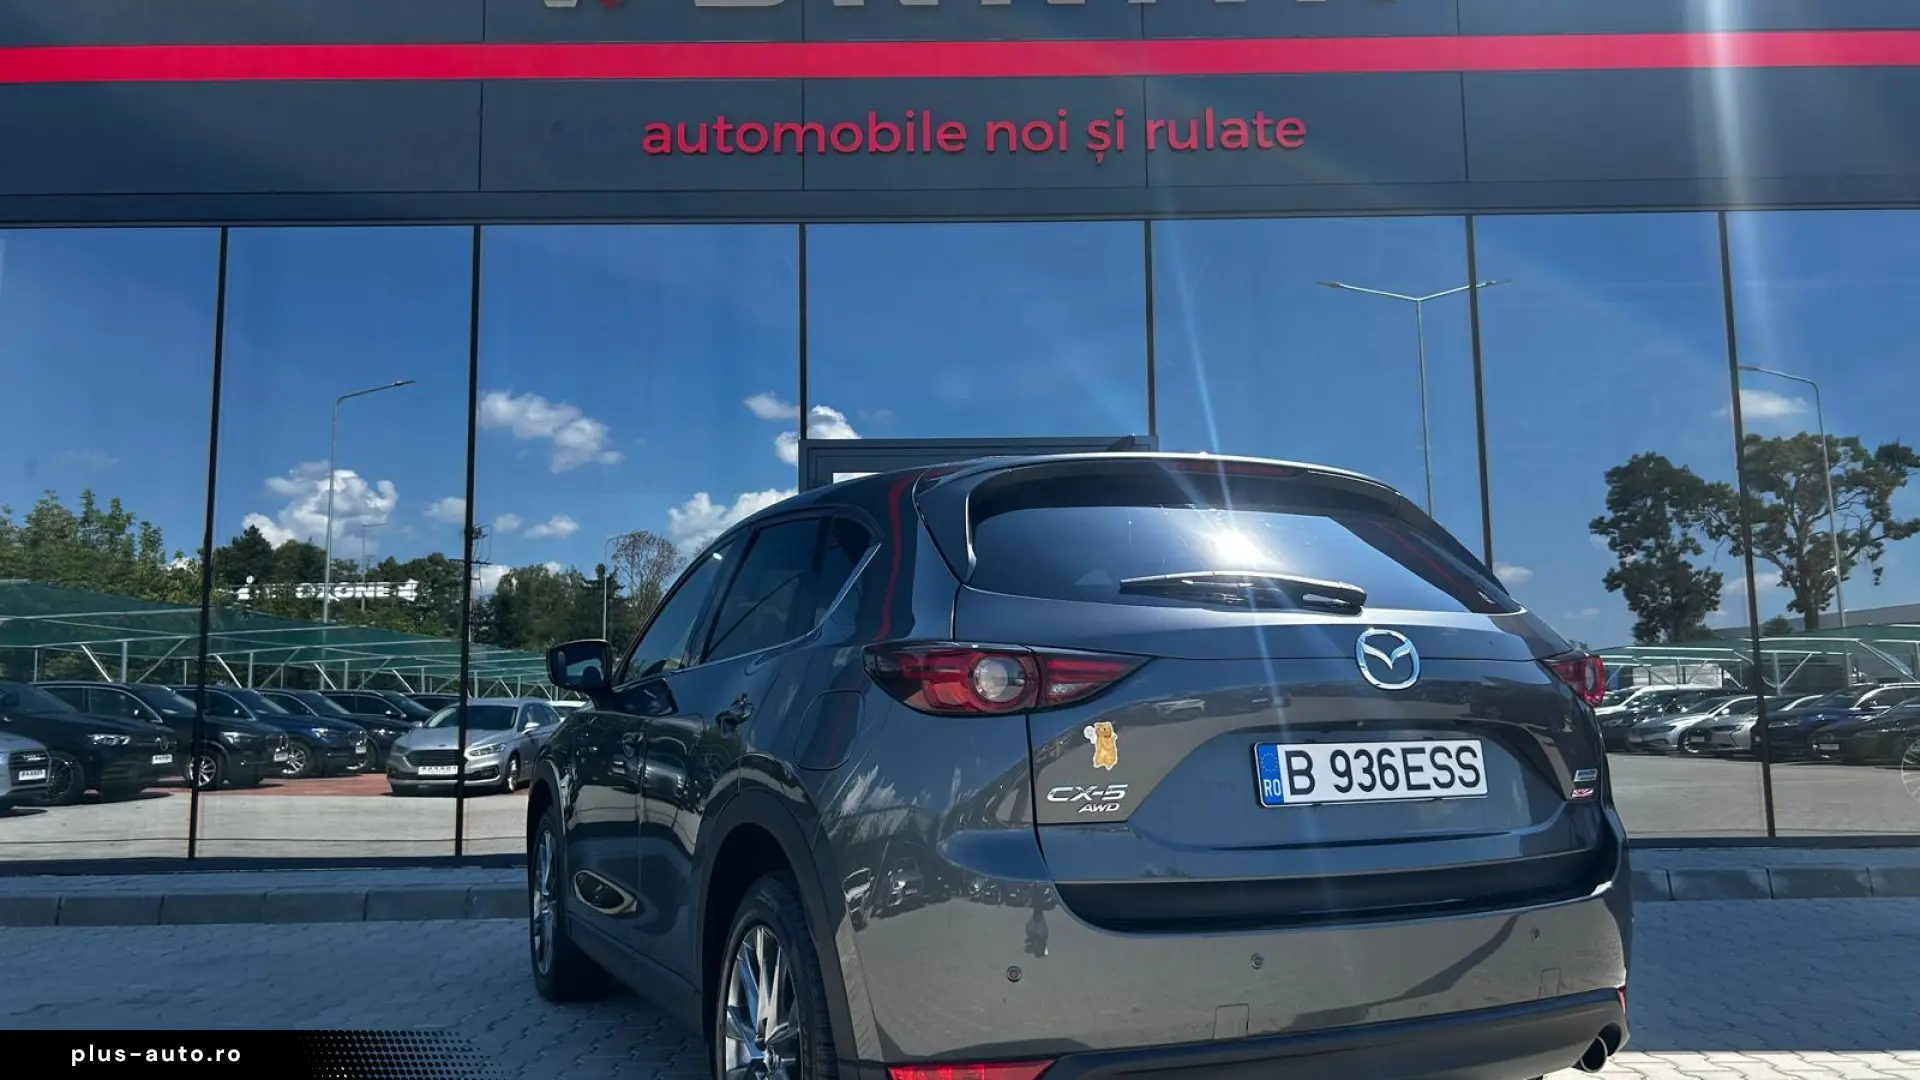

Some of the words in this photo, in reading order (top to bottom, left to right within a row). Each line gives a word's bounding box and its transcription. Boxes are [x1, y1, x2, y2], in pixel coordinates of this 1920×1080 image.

[642, 109, 968, 154] automobile
[986, 109, 1067, 152] noi
[1146, 108, 1308, 152] rulate
[1285, 750, 1316, 796] B
[1047, 784, 1128, 802] CX-5
[1264, 779, 1281, 797] RO
[1078, 802, 1120, 813] AWD
